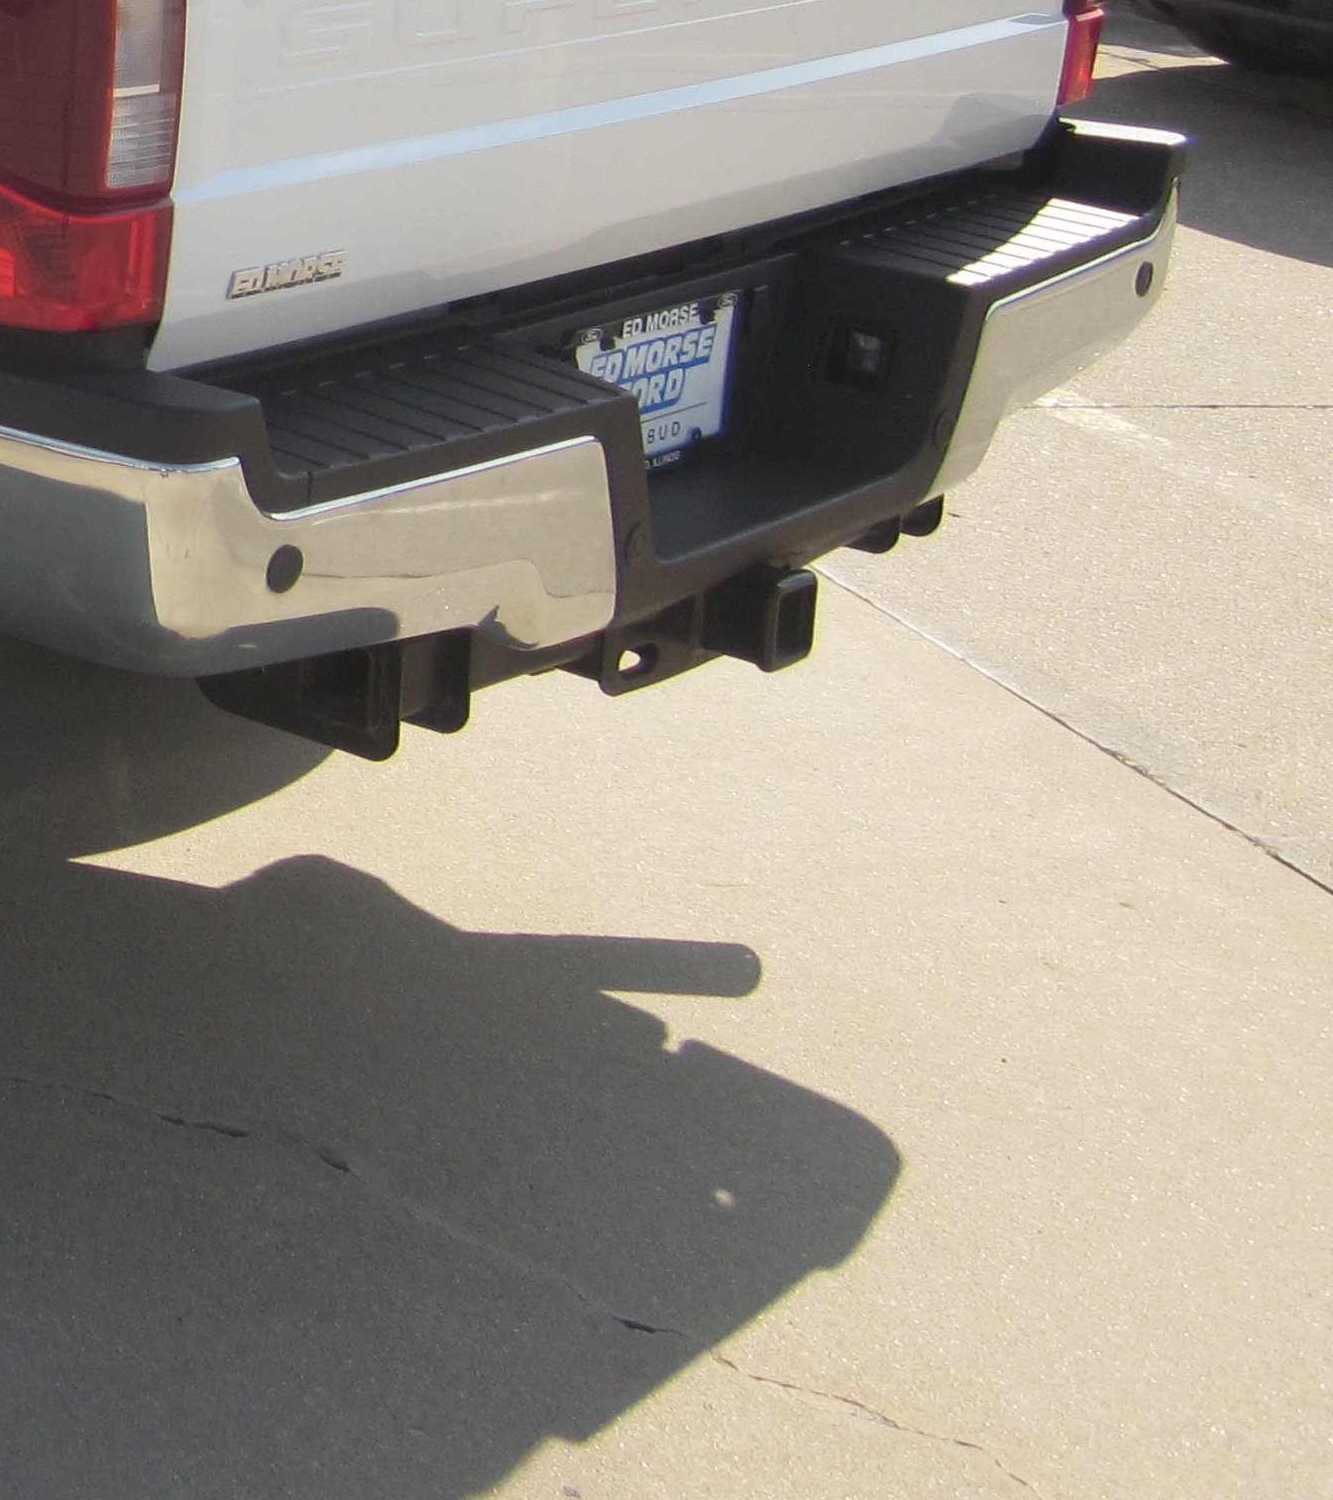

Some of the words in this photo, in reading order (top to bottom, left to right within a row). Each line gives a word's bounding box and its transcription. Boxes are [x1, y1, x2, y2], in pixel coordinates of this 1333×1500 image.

[226, 266, 266, 300] ED
[264, 249, 349, 292] MORSE
[621, 316, 643, 339] ED
[645, 303, 701, 333] MORSE
[590, 350, 625, 383] ED
[622, 325, 718, 380] MORSE
[646, 421, 681, 445] BUD
